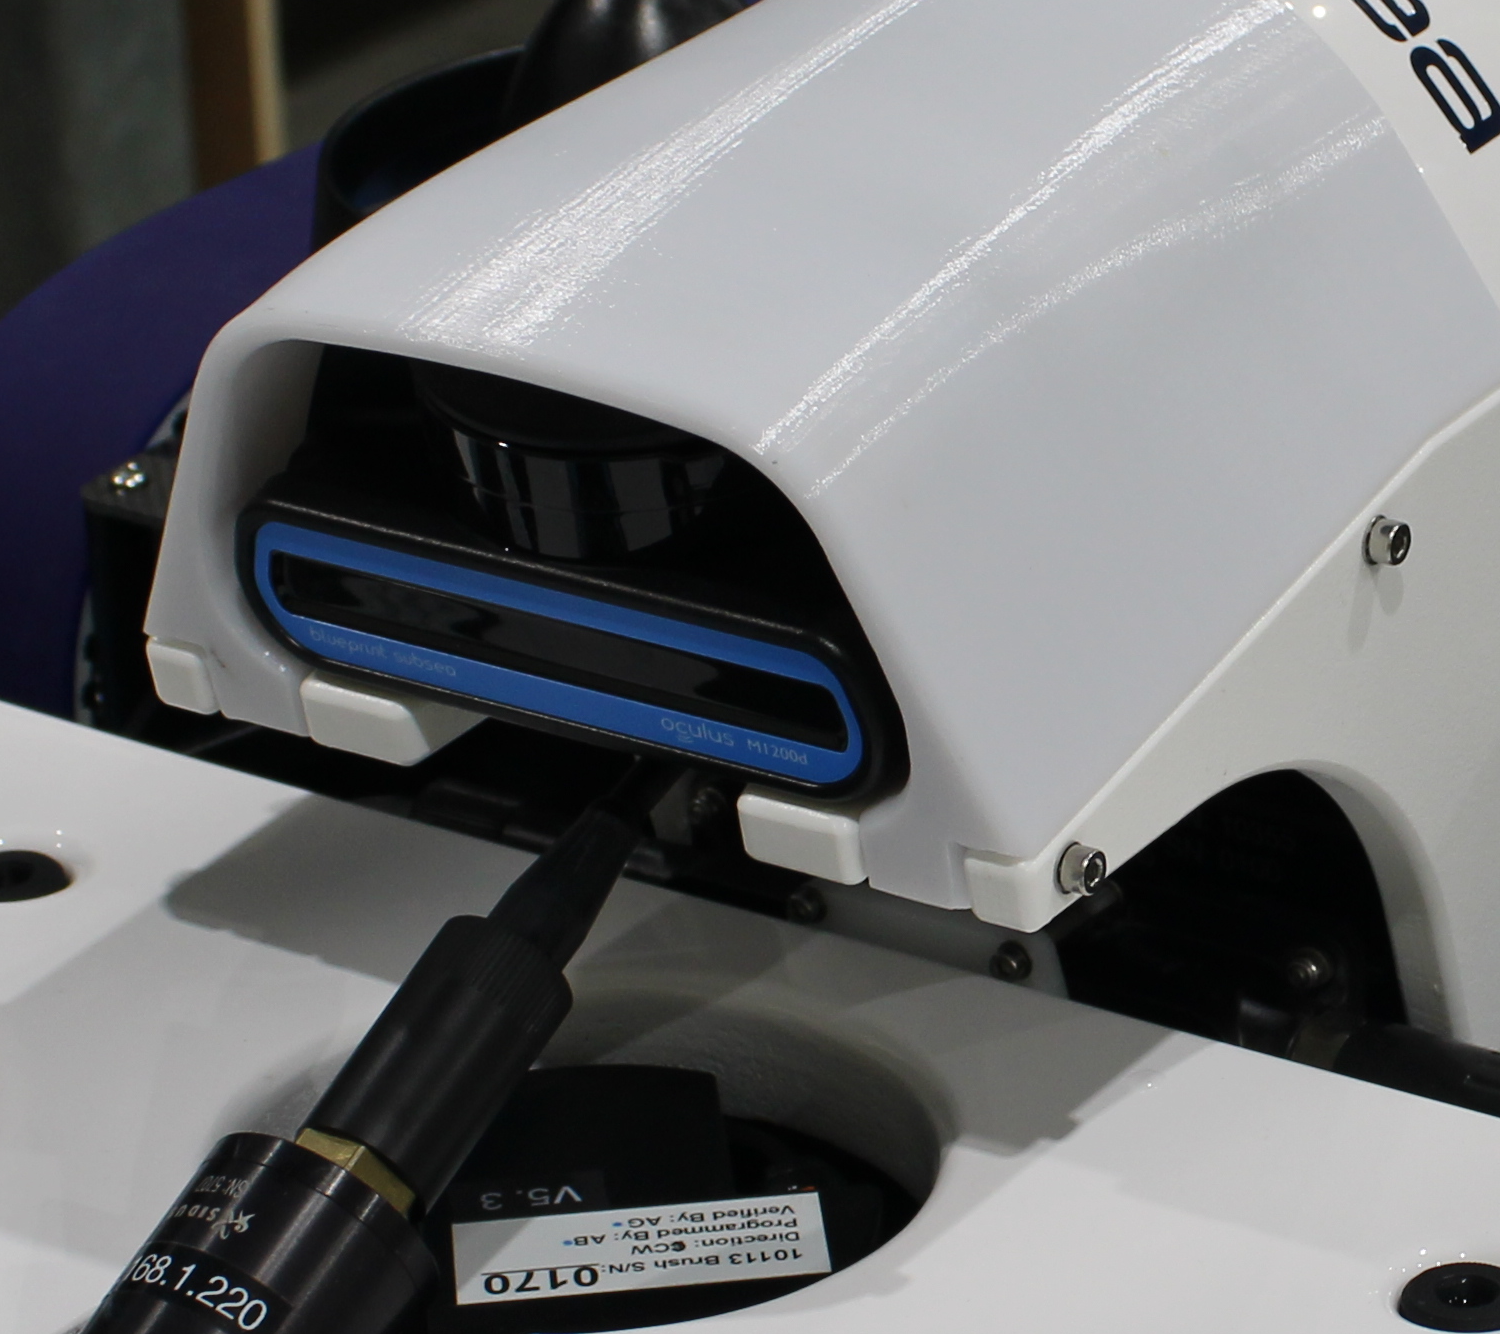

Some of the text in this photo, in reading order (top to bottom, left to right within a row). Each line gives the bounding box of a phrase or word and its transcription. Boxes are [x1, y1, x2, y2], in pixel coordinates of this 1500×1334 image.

[310, 625, 457, 677] blueprint subsea
[661, 717, 809, 766] oculus M1200d
[167, 1203, 222, 1221] SIDU
[626, 1205, 796, 1229] Verified By: AG
[572, 1217, 799, 1246] Programmed By: AB
[694, 1231, 801, 1249] Direction:
[483, 1247, 804, 1295] 10113 Brush S/N: 0170
